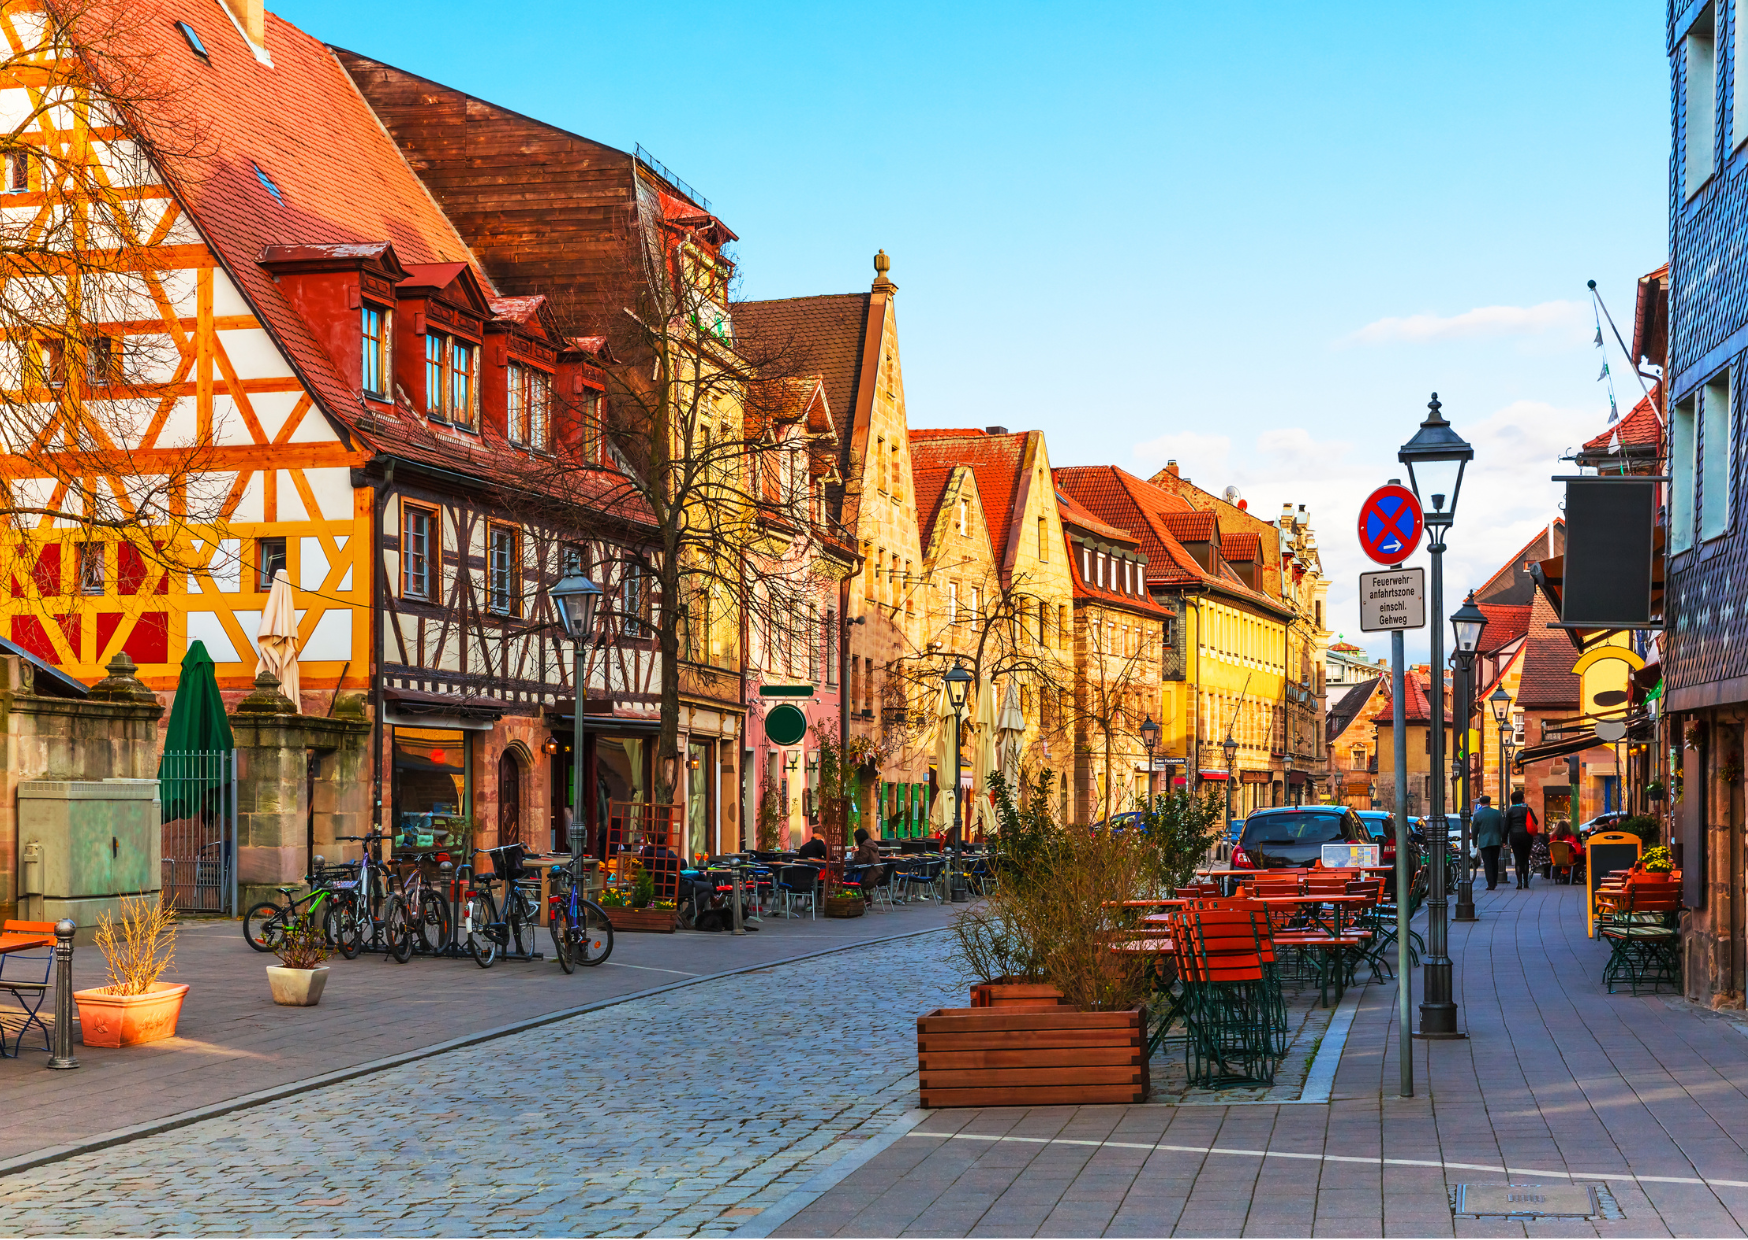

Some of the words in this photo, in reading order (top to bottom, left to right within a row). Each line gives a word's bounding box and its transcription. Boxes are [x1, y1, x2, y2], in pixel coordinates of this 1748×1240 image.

[1373, 575, 1413, 587] Feuerwehr-
[1370, 588, 1414, 599] anfahrtszone
[1379, 601, 1407, 612] einschl.
[1379, 615, 1407, 625] Gehweg
